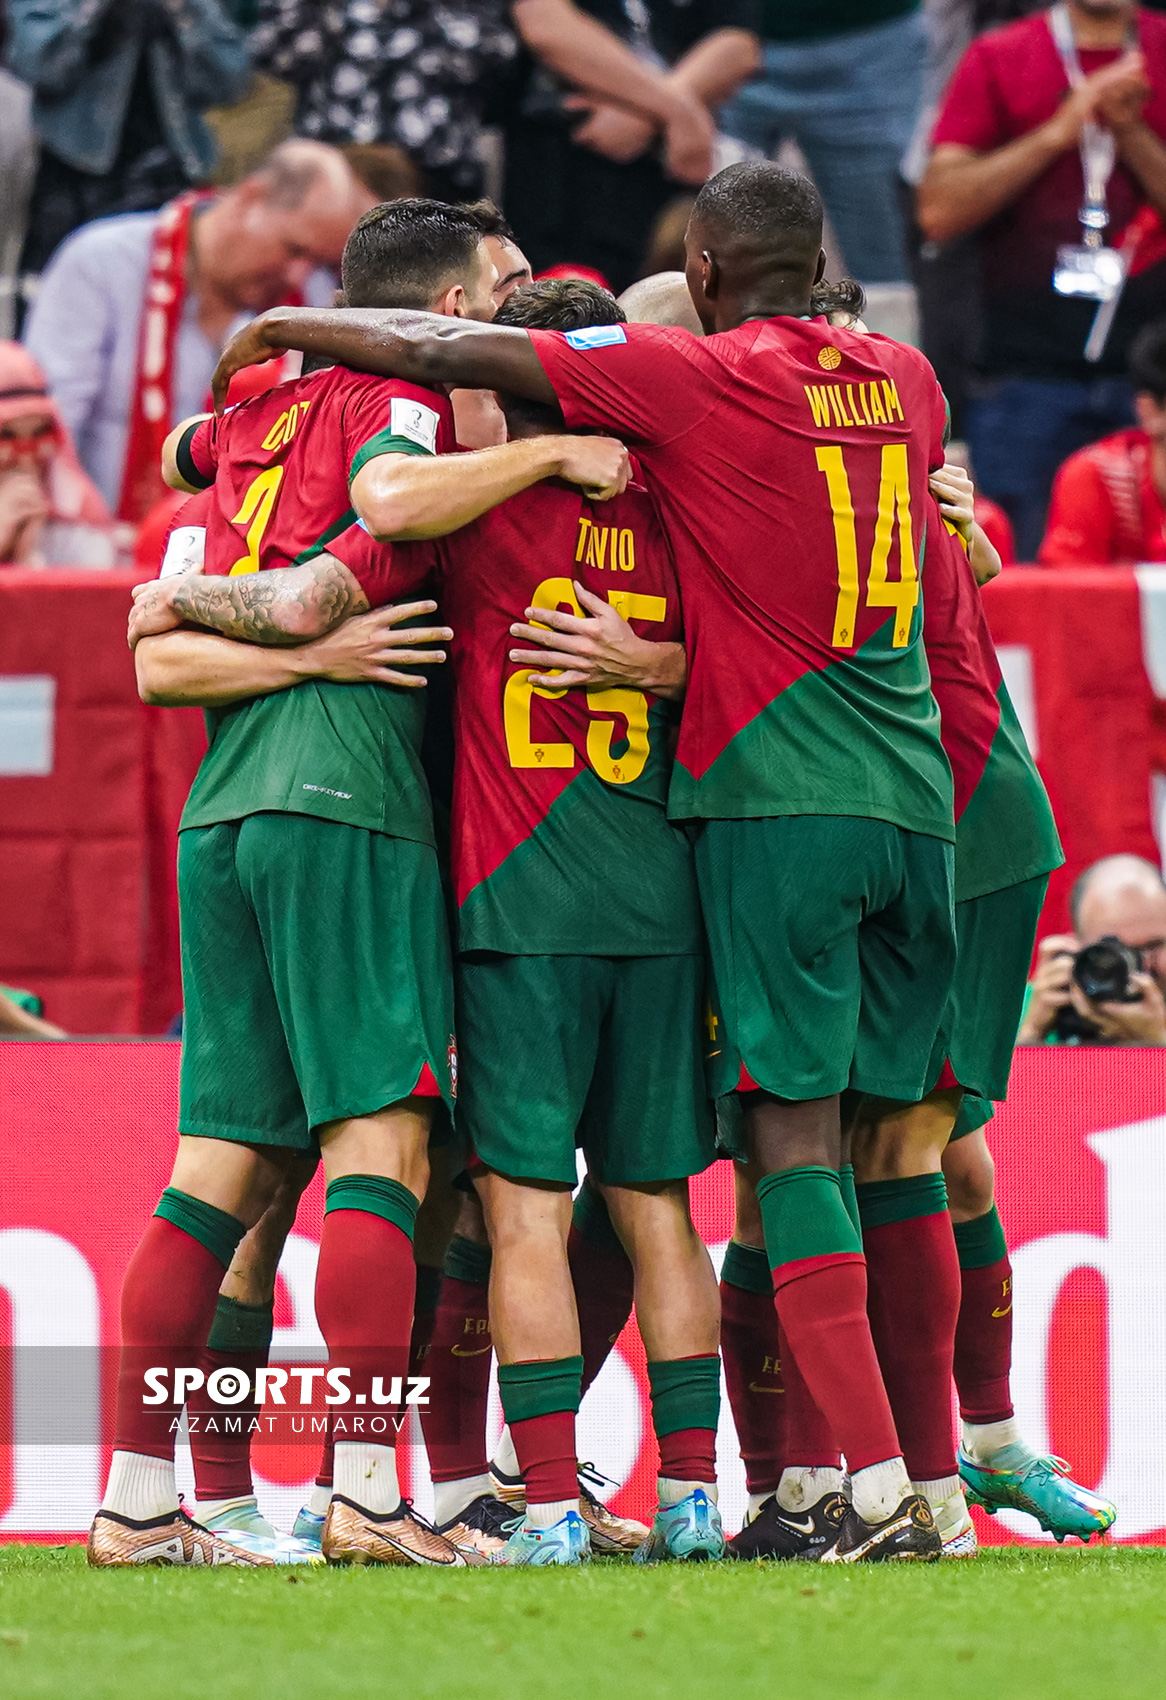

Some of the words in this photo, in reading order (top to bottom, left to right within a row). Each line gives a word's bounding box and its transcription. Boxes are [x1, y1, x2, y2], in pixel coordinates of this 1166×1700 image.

[804, 378, 905, 428] WILLIAM
[815, 444, 919, 648] 14
[504, 577, 667, 784] 25
